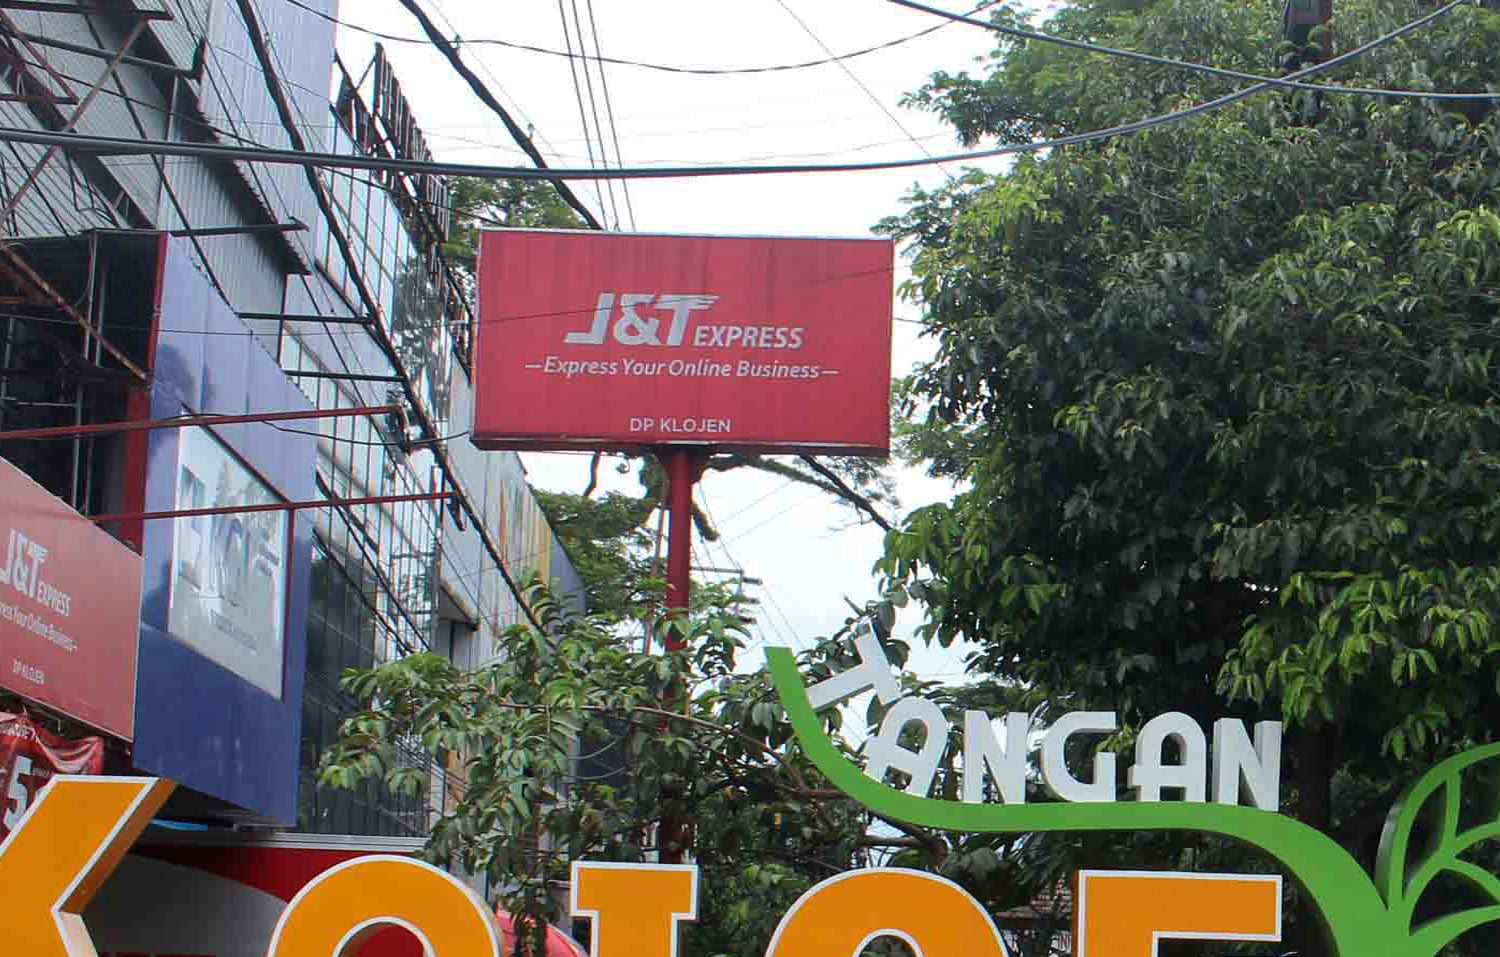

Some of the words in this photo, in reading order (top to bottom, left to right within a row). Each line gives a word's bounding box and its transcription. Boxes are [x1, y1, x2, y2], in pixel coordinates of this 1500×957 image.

[564, 293, 720, 347] J&T
[693, 325, 805, 349] EXPRESS
[622, 358, 666, 376] Your
[668, 359, 732, 378] Online
[629, 417, 654, 433] DP
[660, 418, 731, 433] KLOJEN
[37, 580, 71, 617] EXPRESS
[807, 622, 1283, 812] TANGAN
